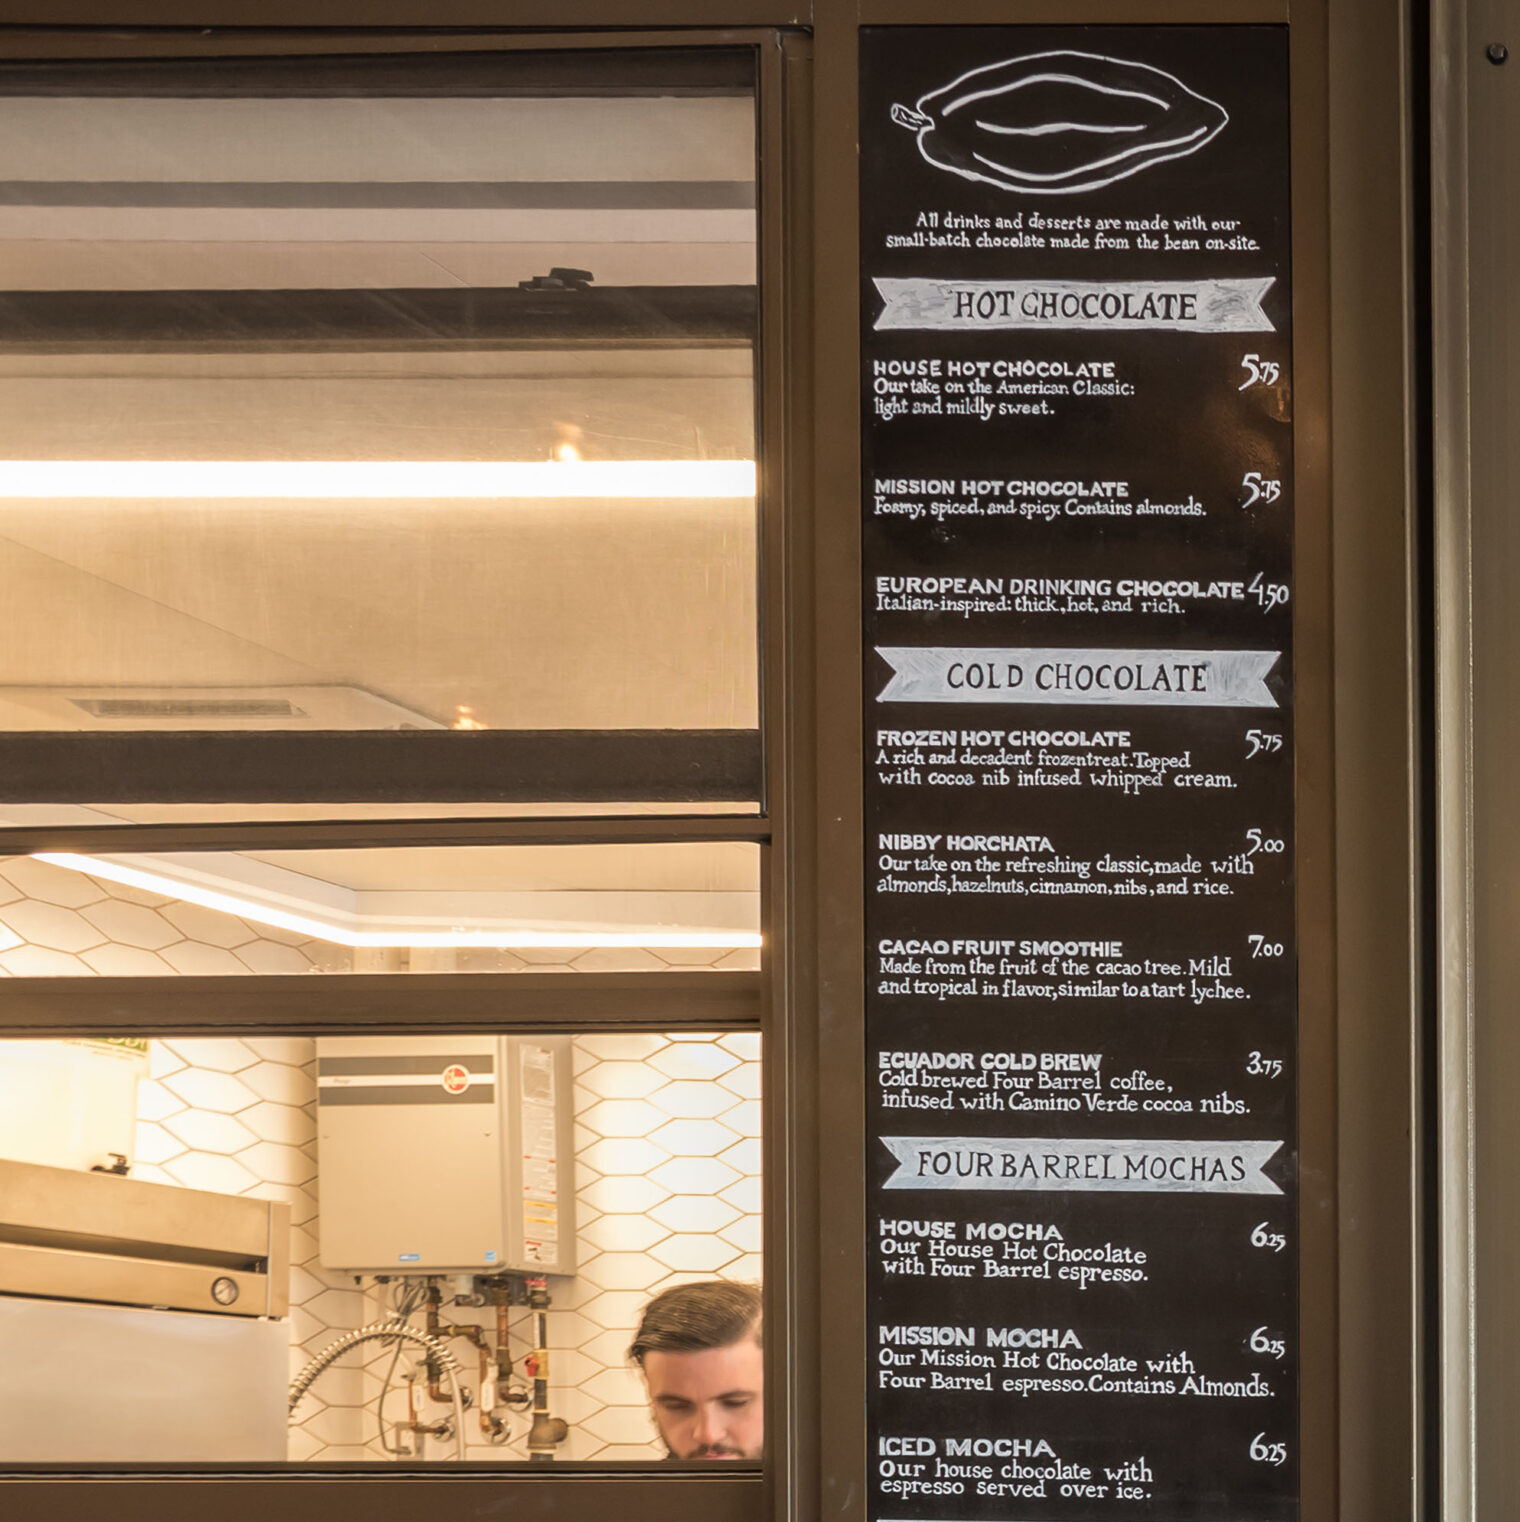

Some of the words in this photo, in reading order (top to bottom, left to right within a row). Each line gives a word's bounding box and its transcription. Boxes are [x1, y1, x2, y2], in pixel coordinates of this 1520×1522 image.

[916, 212, 938, 227] All
[944, 211, 990, 229] drinks
[995, 212, 1023, 229] and
[1029, 212, 1091, 230] desserts
[1095, 219, 1121, 230] are
[1125, 214, 1169, 231] made
[1173, 215, 1208, 231] with
[1212, 221, 1240, 230] our
[886, 231, 971, 248] small-batch
[976, 232, 1045, 247] chocolate
[1050, 233, 1089, 248] made
[1094, 232, 1130, 249] from
[1137, 233, 1159, 249] the
[1164, 234, 1200, 250] bean
[1206, 235, 1260, 250] on-site.
[953, 291, 1015, 318] HOT
[1020, 291, 1198, 320] CHOCOLATE
[874, 360, 942, 377] HOUSE
[948, 361, 990, 377] HOT
[993, 360, 1115, 377] CHOCOLATE
[874, 377, 908, 394] Our
[910, 378, 940, 394] take
[945, 382, 965, 393] on
[967, 378, 992, 394] the
[996, 380, 1069, 394] American
[1073, 379, 1134, 395] Classic:
[874, 396, 908, 421] light
[912, 395, 943, 414] and
[946, 396, 996, 421] mildly
[999, 400, 1054, 415] sweet.
[875, 479, 955, 494] MISSION
[962, 481, 1004, 495] HOT
[1007, 481, 1128, 497] CHOCOLATE
[877, 577, 1003, 594] EUROPEAN
[1010, 579, 1111, 595] DRINKING
[1117, 580, 1244, 599] CHOCOLATE
[946, 662, 1023, 690] COLD
[1034, 662, 1209, 693] CHOCOLATE
[877, 730, 957, 746] FROZEN
[961, 731, 1005, 746] HOT
[1008, 731, 1130, 747] CHOCOLATE
[879, 767, 921, 784] with
[928, 772, 975, 785] cocoa
[982, 768, 1010, 785] nib
[1018, 768, 1082, 786] infused
[1090, 771, 1165, 795] whipped
[1174, 774, 1237, 787] cream.
[879, 834, 942, 850] NIBBY
[947, 835, 1055, 852] HORCHATA
[879, 940, 949, 955] CACAO
[953, 940, 1015, 955] FRUIT
[1019, 941, 1122, 957] SMOOTHIE
[879, 1052, 975, 1070] ECUADOR
[981, 1053, 1037, 1070] COLD
[1041, 1053, 1102, 1071] BREW
[879, 1071, 921, 1086] Cold
[921, 1071, 989, 1088] brewed
[993, 1072, 1033, 1089] Four
[1037, 1071, 1101, 1089] Barrel
[1110, 1070, 1172, 1093] coffee,
[882, 1088, 954, 1109] infused
[960, 1092, 1005, 1111] with
[1009, 1091, 1081, 1111] Camino
[1082, 1093, 1138, 1112] Verde
[1143, 1100, 1193, 1112] cocoa
[1200, 1091, 1250, 1114] nibs.
[916, 1151, 995, 1178] FOUR
[1001, 1152, 1118, 1181] BARREL
[1124, 1155, 1248, 1182] MOCHAS
[880, 1219, 956, 1239] HOUSE
[966, 1223, 1063, 1240] MOCHA
[881, 1239, 921, 1255] Our
[928, 1240, 993, 1258] House
[1002, 1242, 1037, 1260] Hot
[1043, 1243, 1146, 1264] Chocolate
[882, 1256, 925, 1275] with
[930, 1258, 975, 1277] Four
[983, 1260, 1051, 1279] Barrel
[1058, 1265, 1148, 1290] espresso.
[880, 1326, 975, 1346] MISSION
[987, 1328, 1083, 1349] MOCHA
[879, 1348, 915, 1366] Our
[920, 1349, 996, 1368] Mission
[1003, 1351, 1040, 1368] Hot
[1047, 1352, 1137, 1372] Chocolate
[1146, 1351, 1195, 1374] with
[879, 1437, 936, 1456] ICED
[946, 1439, 1056, 1457] MOCHA
[880, 1460, 925, 1477] Our
[935, 1457, 993, 1479] house
[1001, 1458, 1091, 1481] chocolate
[1104, 1456, 1153, 1482] with
[881, 1480, 964, 1499] espresso
[976, 1479, 1048, 1497] served
[1060, 1484, 1108, 1498] over
[1116, 1482, 1151, 1499] ice.
